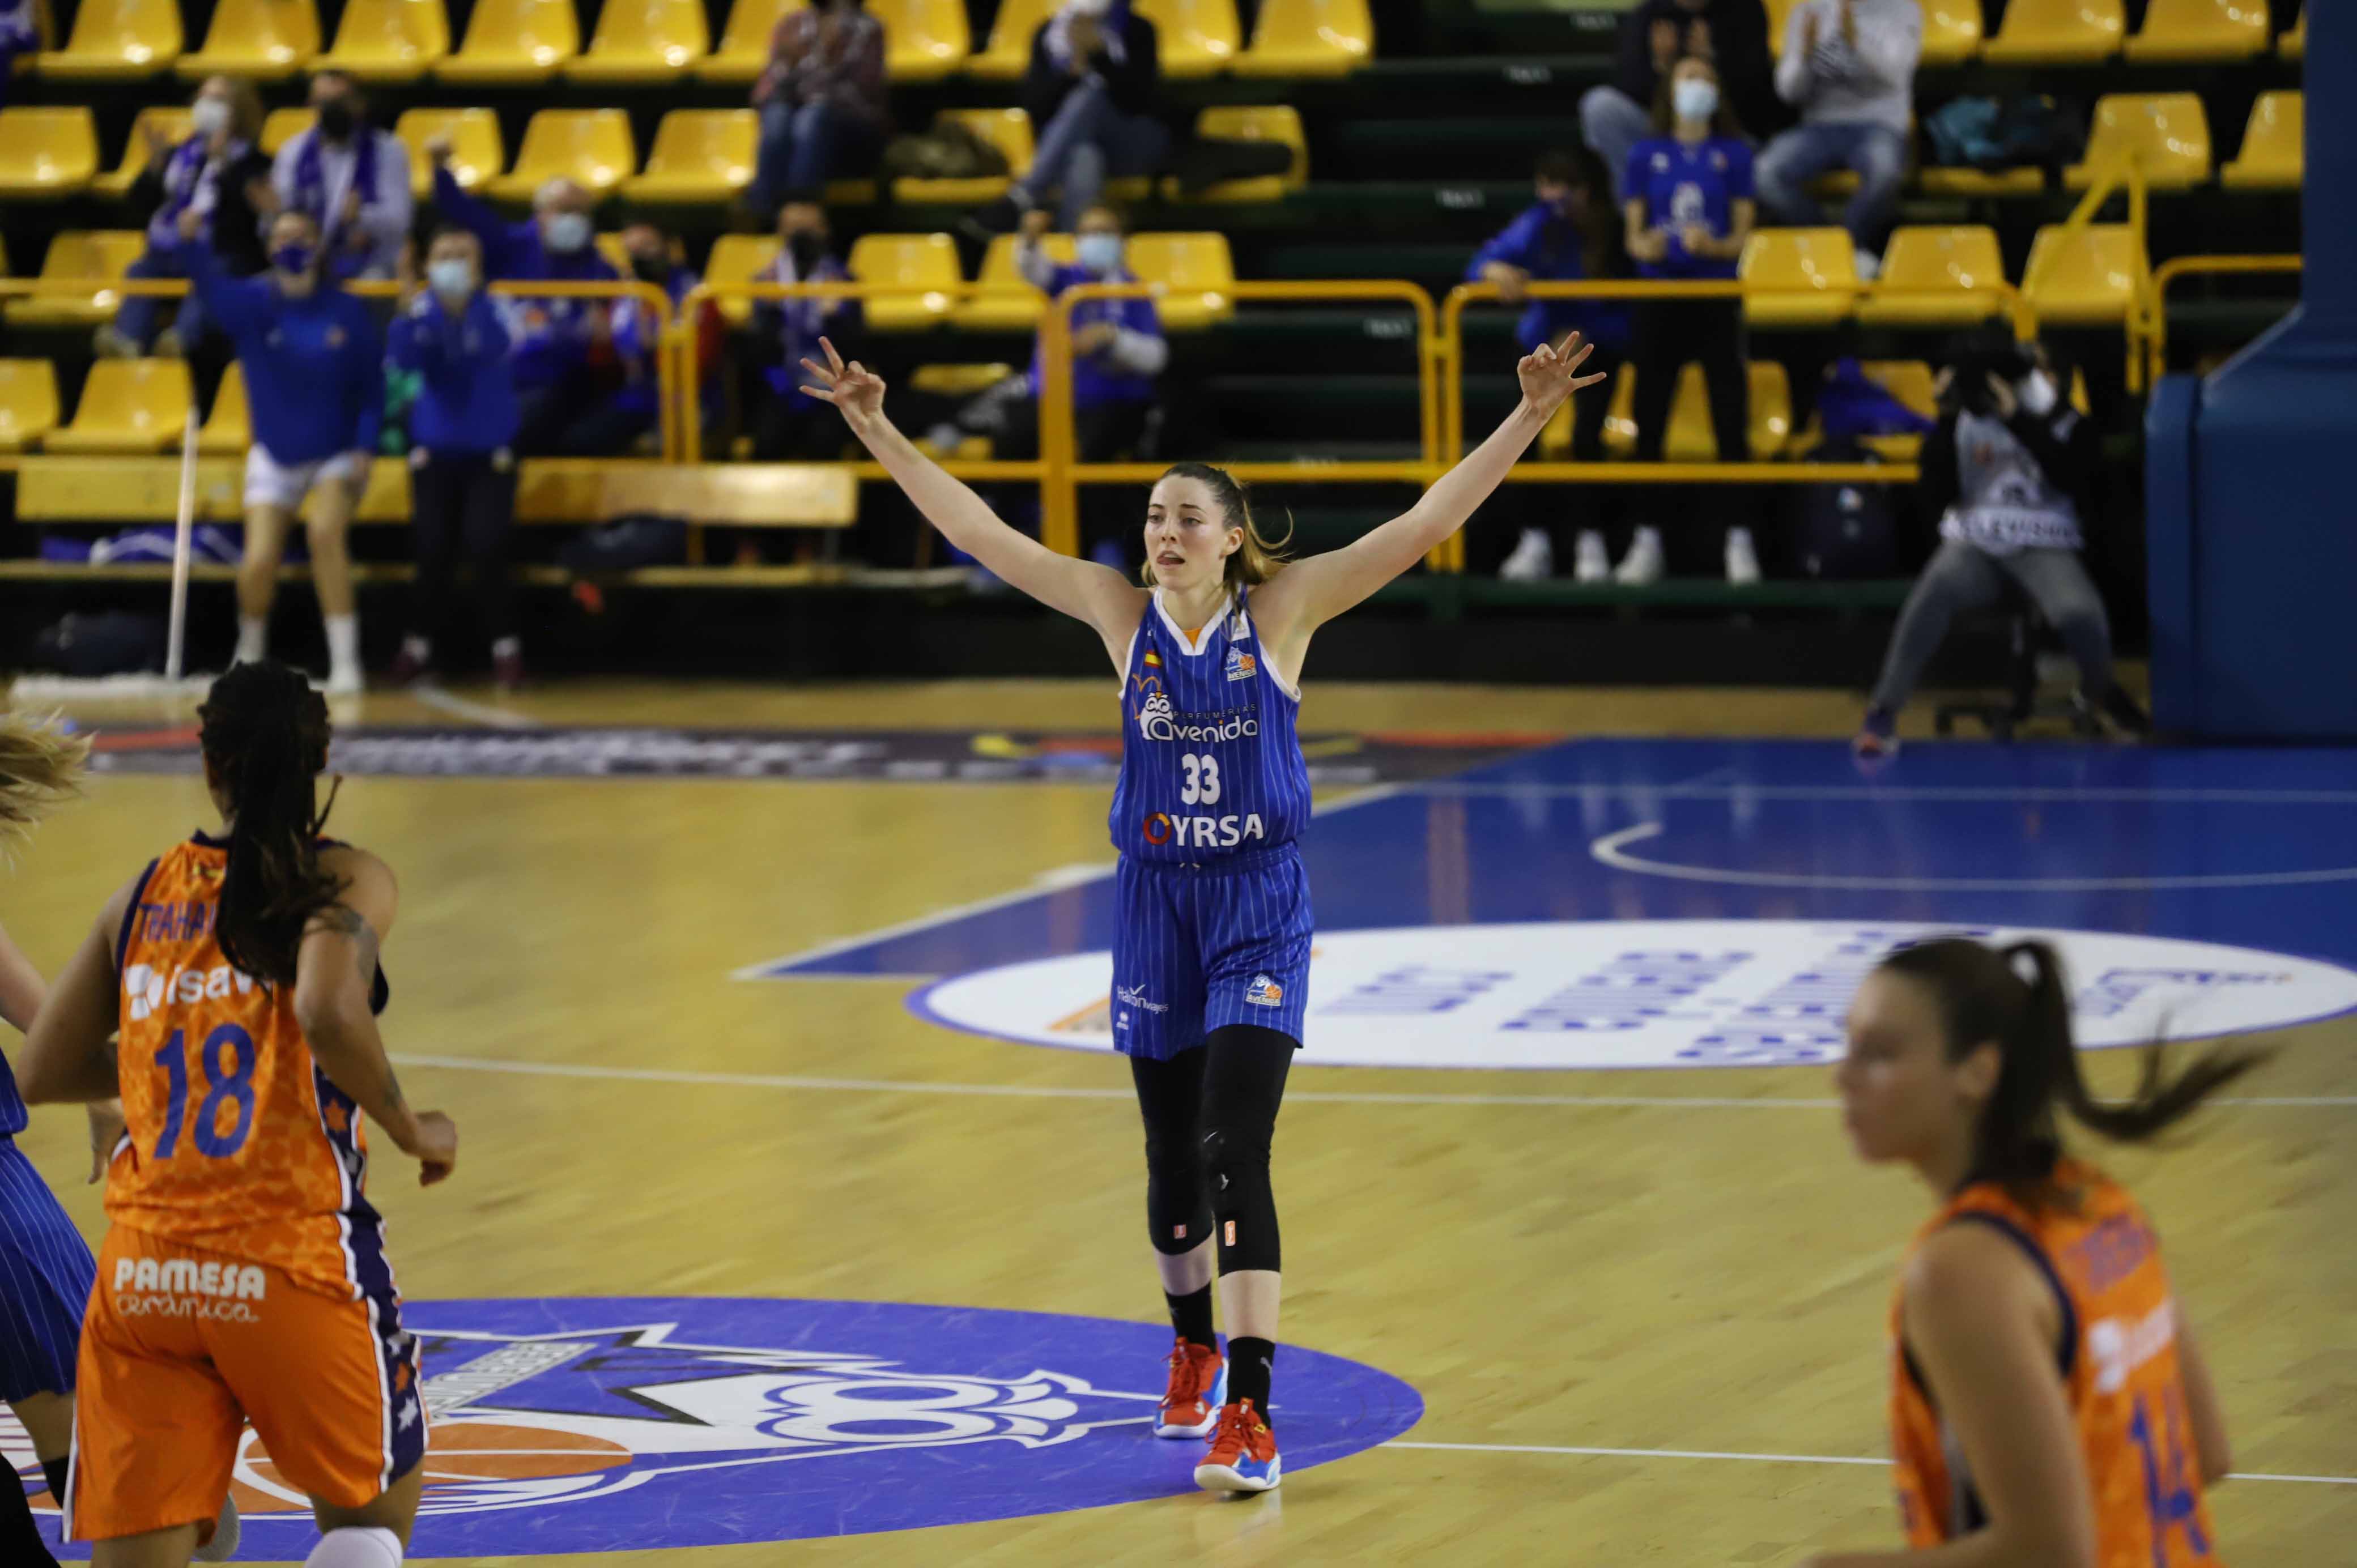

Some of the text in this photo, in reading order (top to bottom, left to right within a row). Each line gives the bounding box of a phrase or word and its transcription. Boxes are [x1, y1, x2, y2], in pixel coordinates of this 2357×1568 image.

[1182, 753, 1220, 804] 33
[1143, 812, 1263, 847] OYRSA
[153, 1023, 255, 1159] 18
[114, 1257, 265, 1299] PAMESA
